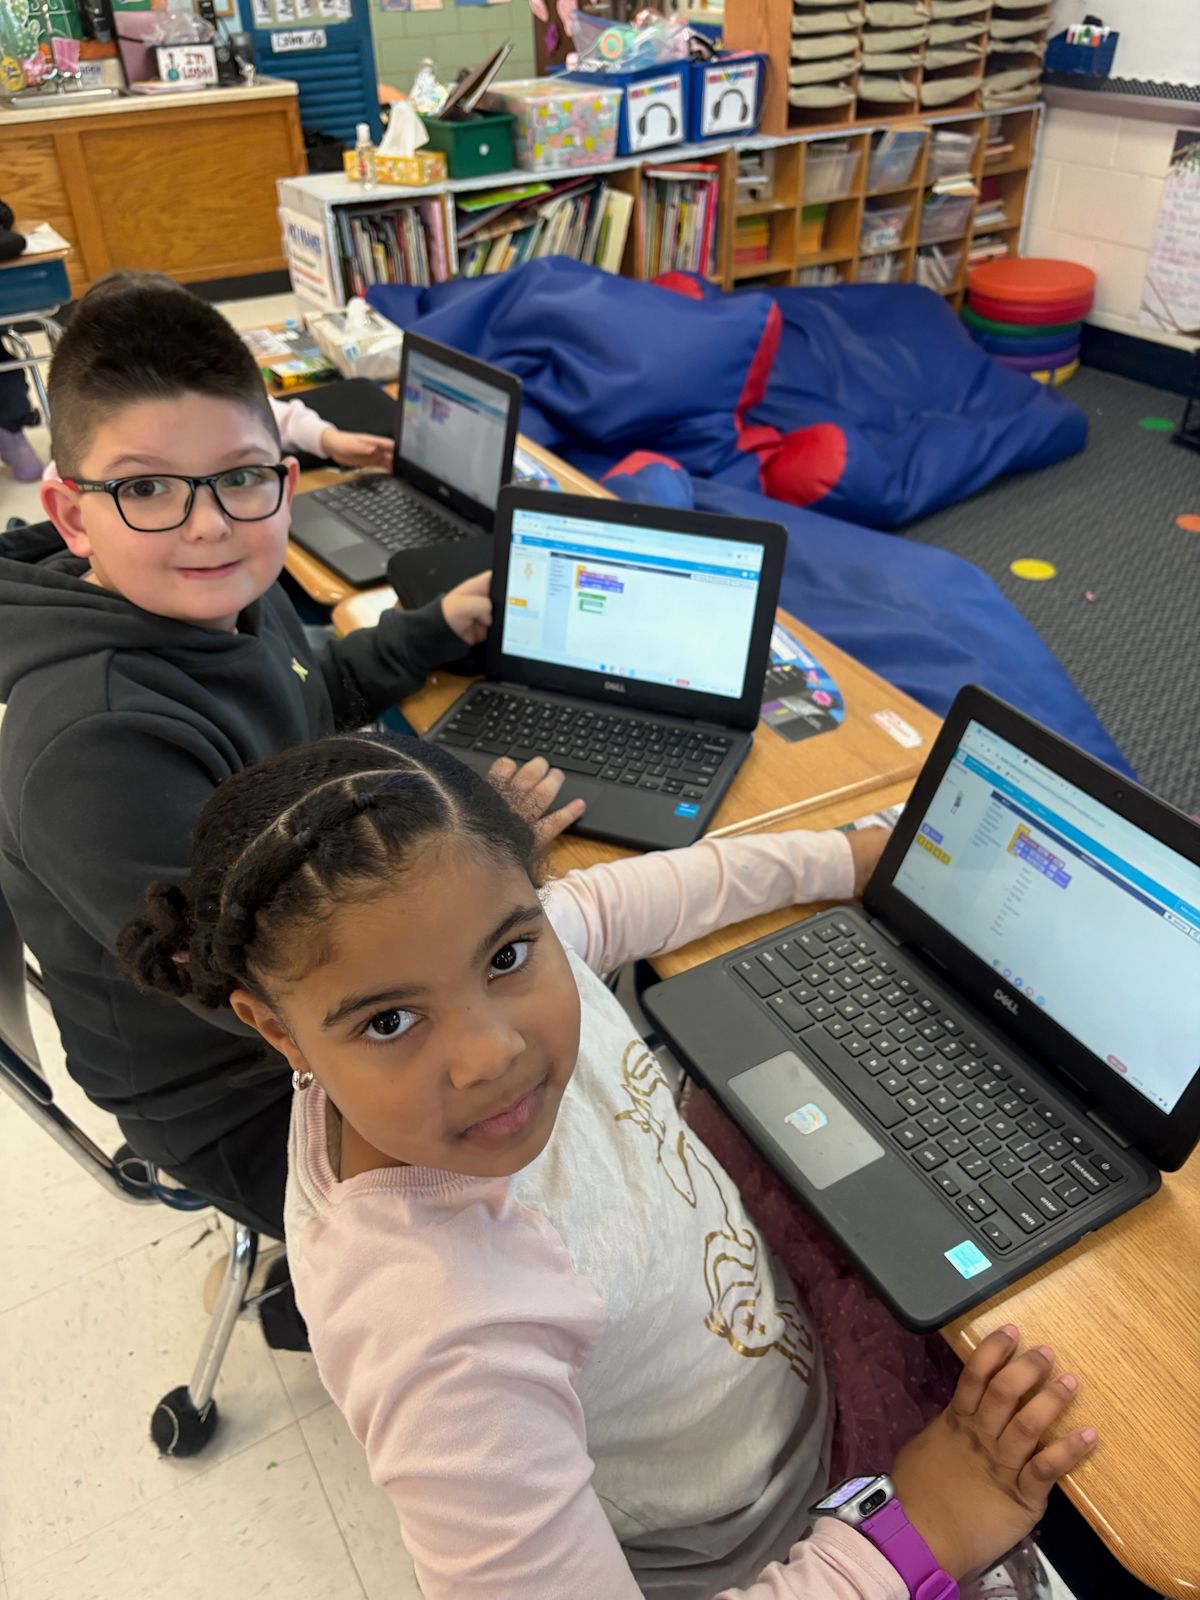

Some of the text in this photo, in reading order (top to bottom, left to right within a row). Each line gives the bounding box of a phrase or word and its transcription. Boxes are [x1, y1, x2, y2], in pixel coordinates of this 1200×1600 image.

[993, 987, 1019, 1016] DELL
[1071, 1160, 1099, 1186] backspace
[1040, 1197, 1057, 1211] enter
[1021, 1213, 1035, 1225] shift
